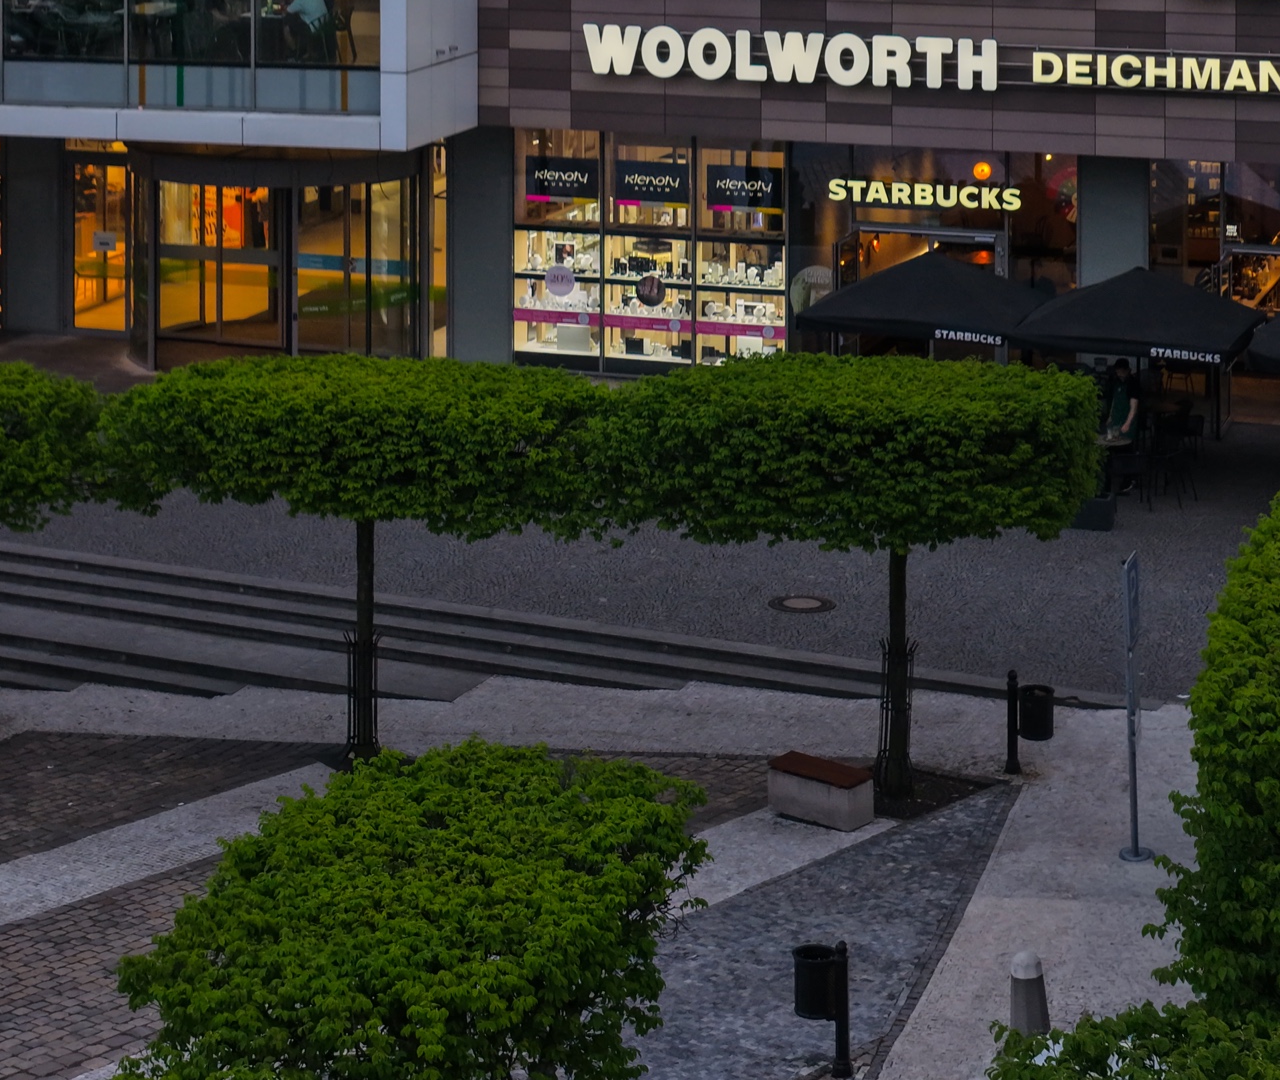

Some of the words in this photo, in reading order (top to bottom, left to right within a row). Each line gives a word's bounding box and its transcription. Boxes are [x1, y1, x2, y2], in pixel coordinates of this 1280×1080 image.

[583, 24, 997, 91] WOOLWORTH
[828, 178, 1022, 211] STARBUCKS
[934, 329, 1002, 345] STARBUCKS
[1150, 347, 1221, 363] STARBUCKS
